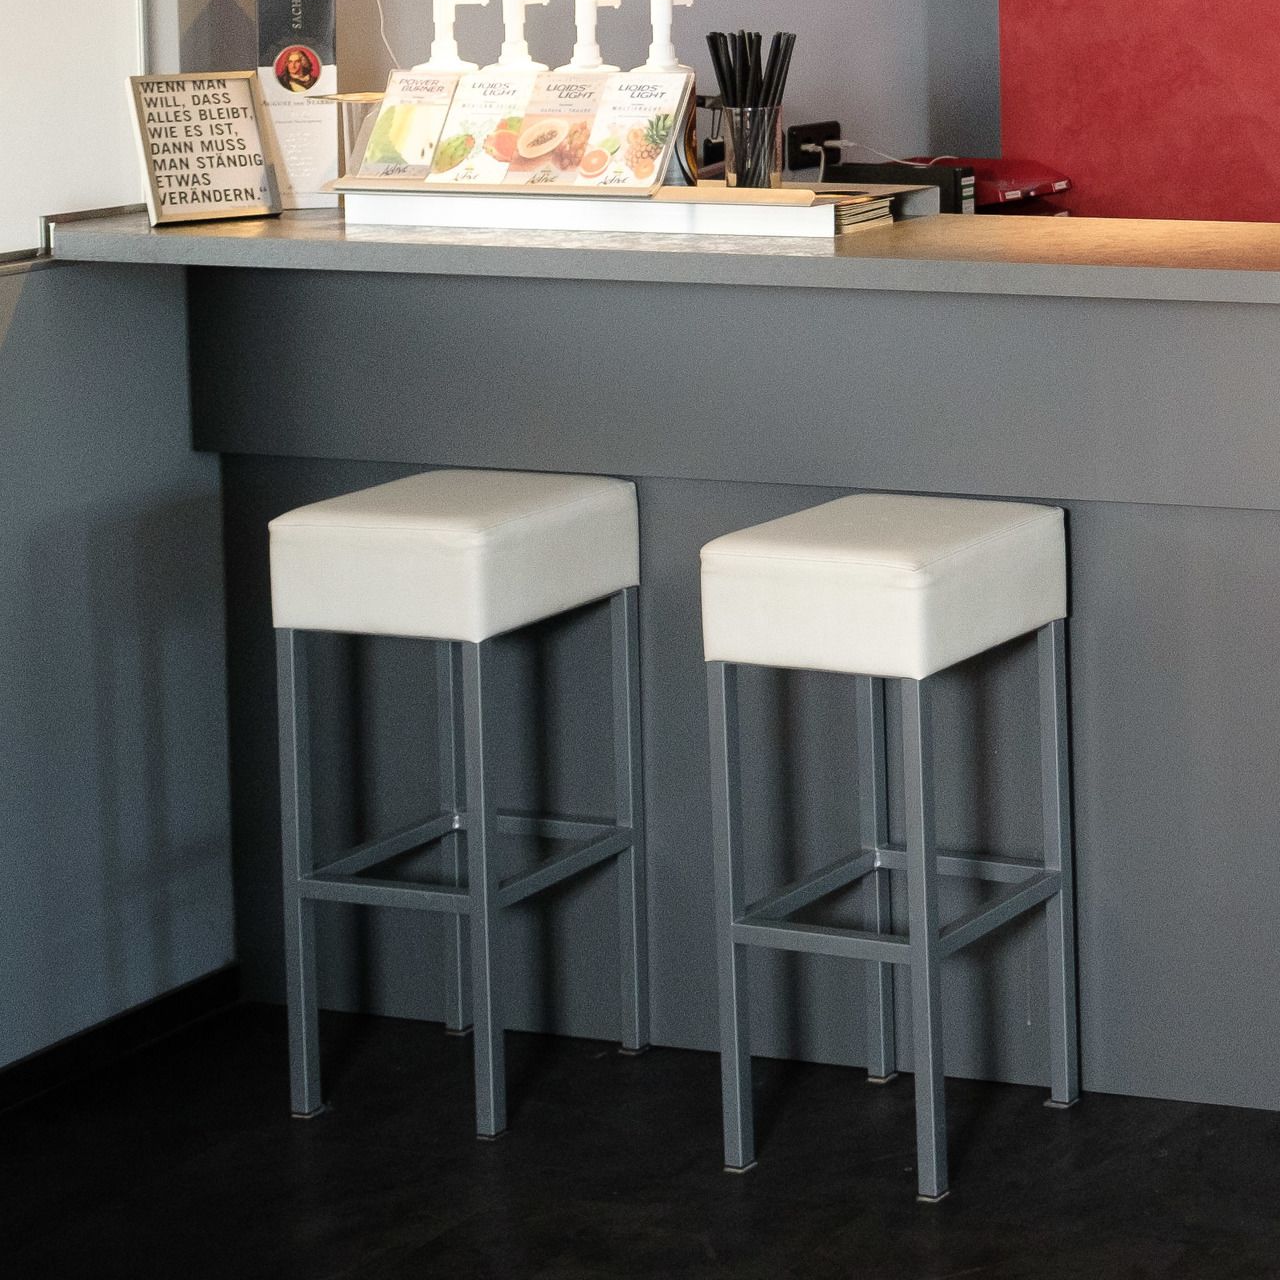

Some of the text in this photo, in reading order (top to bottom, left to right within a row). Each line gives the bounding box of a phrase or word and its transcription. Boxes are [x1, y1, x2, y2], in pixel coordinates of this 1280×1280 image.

[141, 79, 227, 94] WENN MAN
[482, 89, 518, 97] LIGHT
[143, 92, 231, 109] WILL, DASS
[558, 91, 595, 99] LIGHT
[630, 91, 667, 99] LIGHT
[146, 106, 254, 124] ALLES BLEIBT,
[148, 123, 239, 139] WIE ES IST,
[150, 138, 247, 155] DANN MUSS
[153, 152, 264, 172] MAN STÄNDIG
[156, 173, 212, 189] ETWAS
